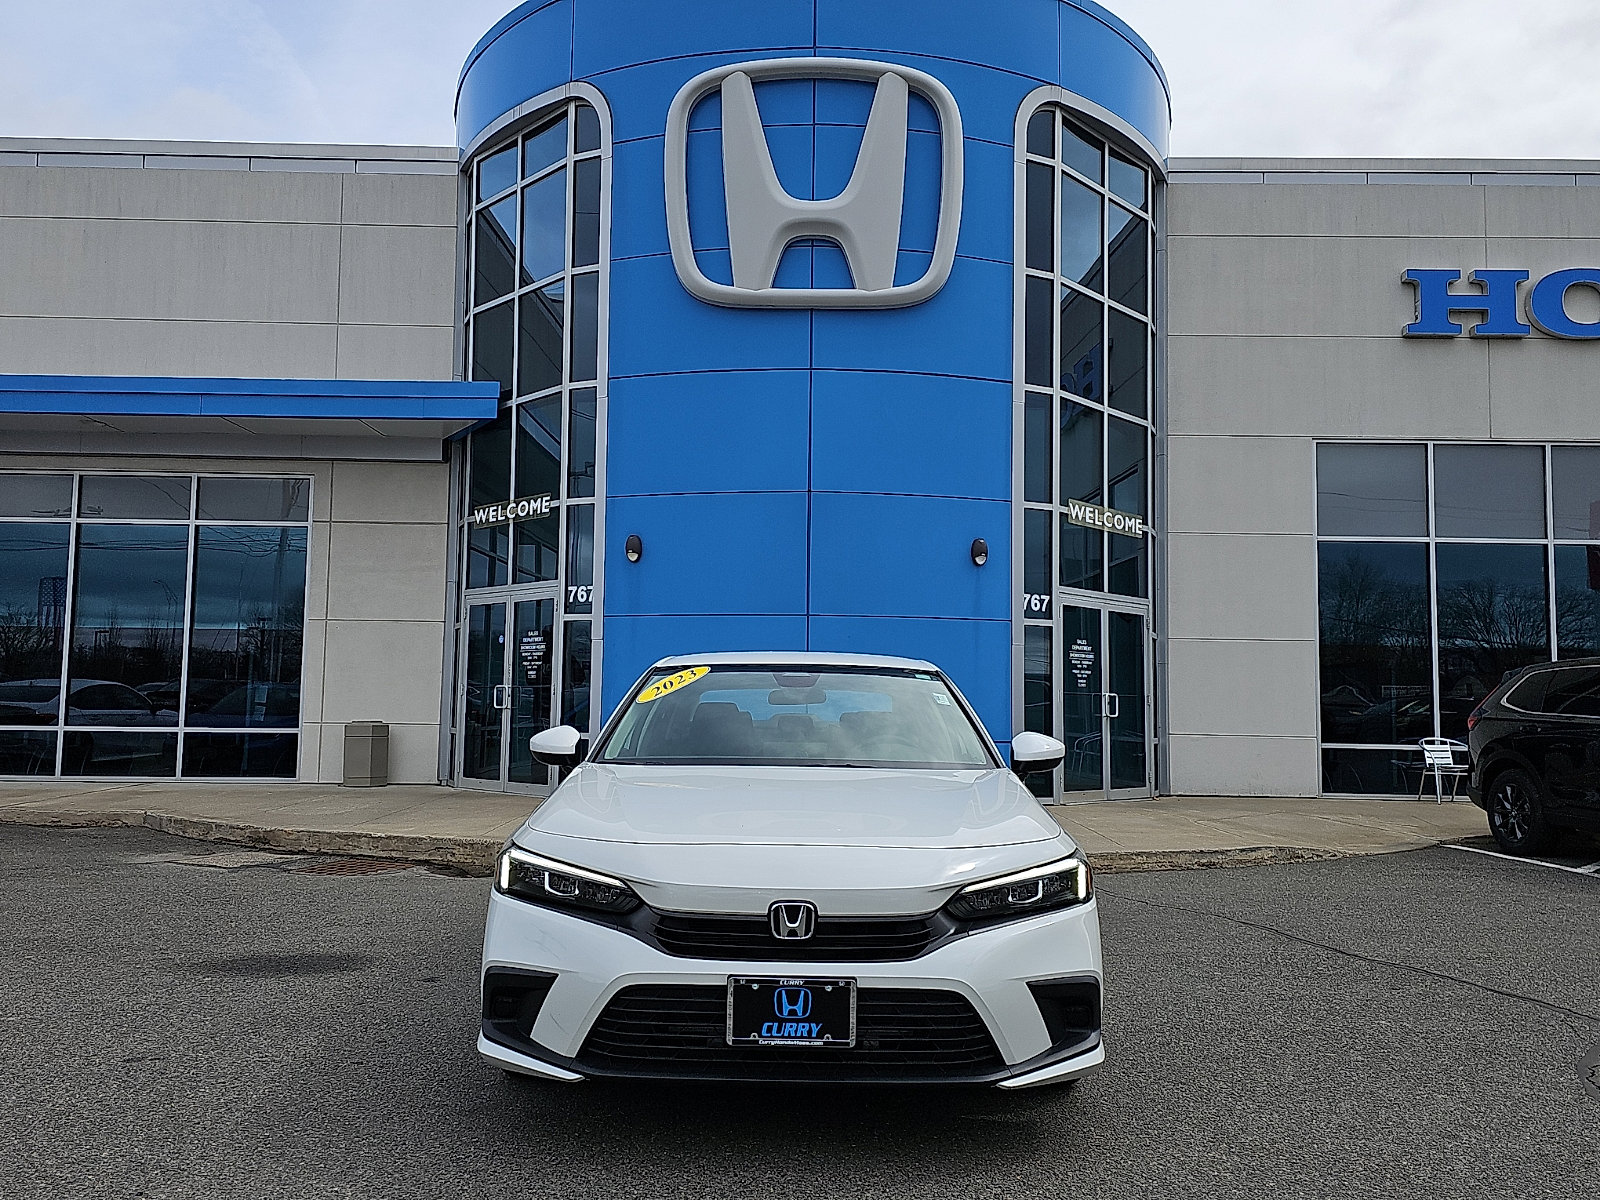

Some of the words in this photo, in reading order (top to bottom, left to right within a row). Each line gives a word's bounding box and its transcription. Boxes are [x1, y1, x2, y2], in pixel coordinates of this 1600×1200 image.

[1401, 267, 1600, 340] HO
[474, 496, 551, 525] WELCOME
[1069, 501, 1143, 534] WELCOME
[567, 585, 594, 603] 767
[1023, 593, 1050, 612] 767
[651, 670, 697, 697] 2023
[761, 1022, 823, 1038] CURRY
